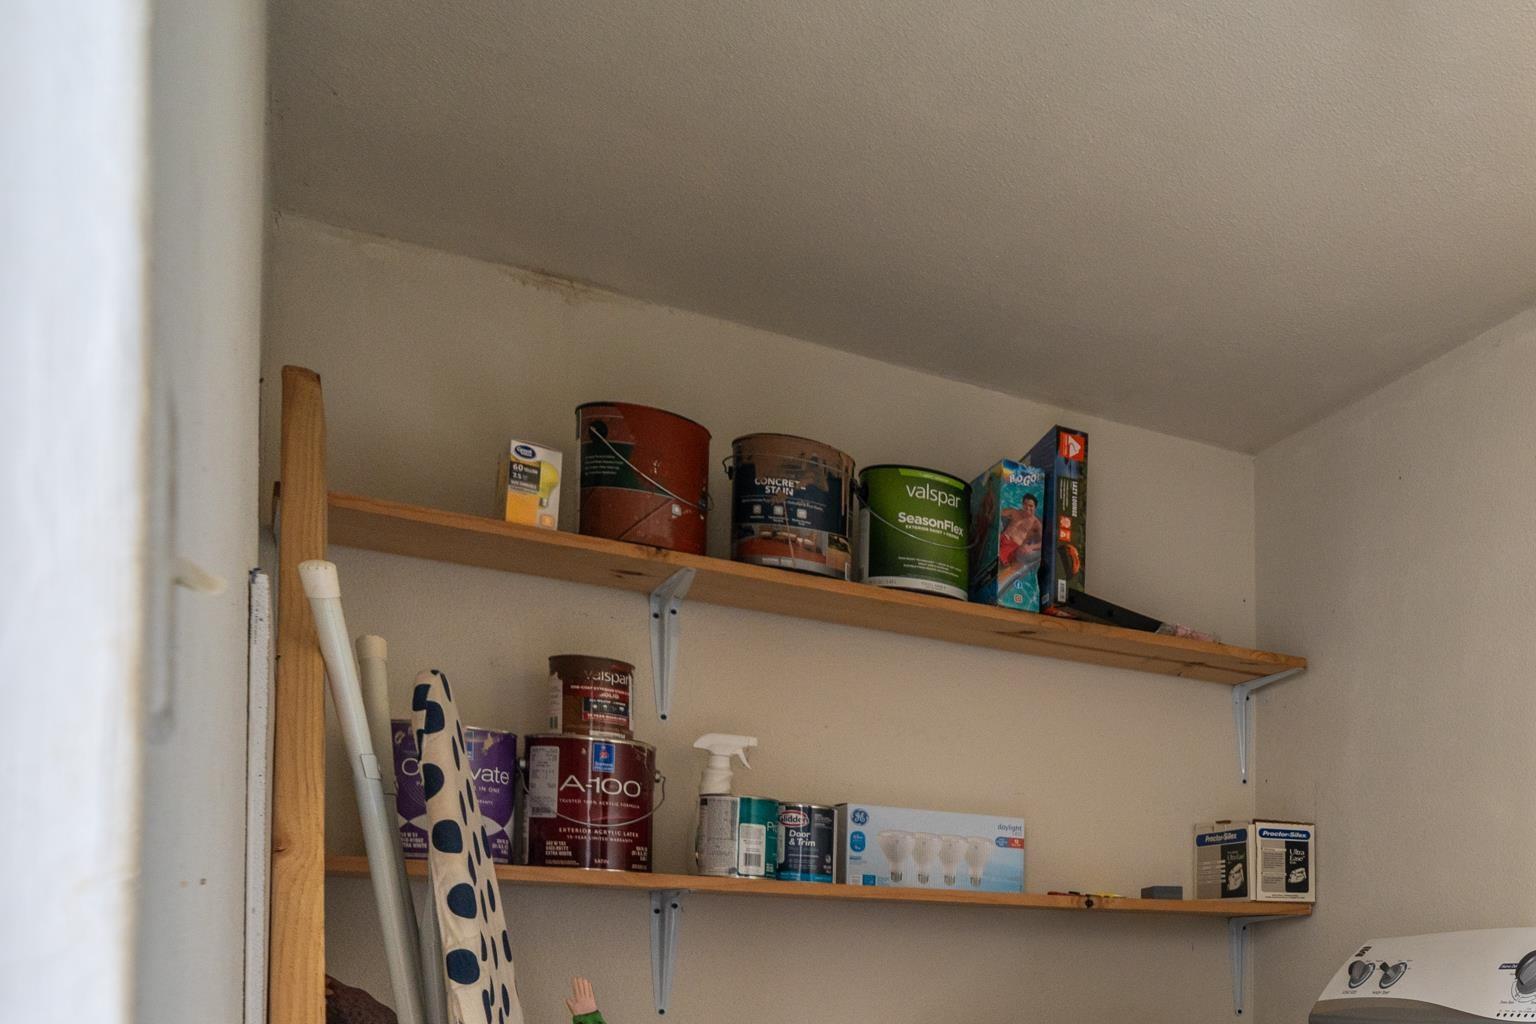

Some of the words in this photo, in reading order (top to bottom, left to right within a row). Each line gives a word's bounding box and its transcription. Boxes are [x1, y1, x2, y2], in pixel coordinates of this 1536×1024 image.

[906, 483, 961, 508] valspar
[898, 512, 964, 537] SeasonFlex
[560, 775, 641, 798] A-100
[594, 829, 621, 837] ACRYLIC
[788, 829, 811, 838] Door
[788, 838, 796, 846] &
[797, 838, 816, 847] Trim
